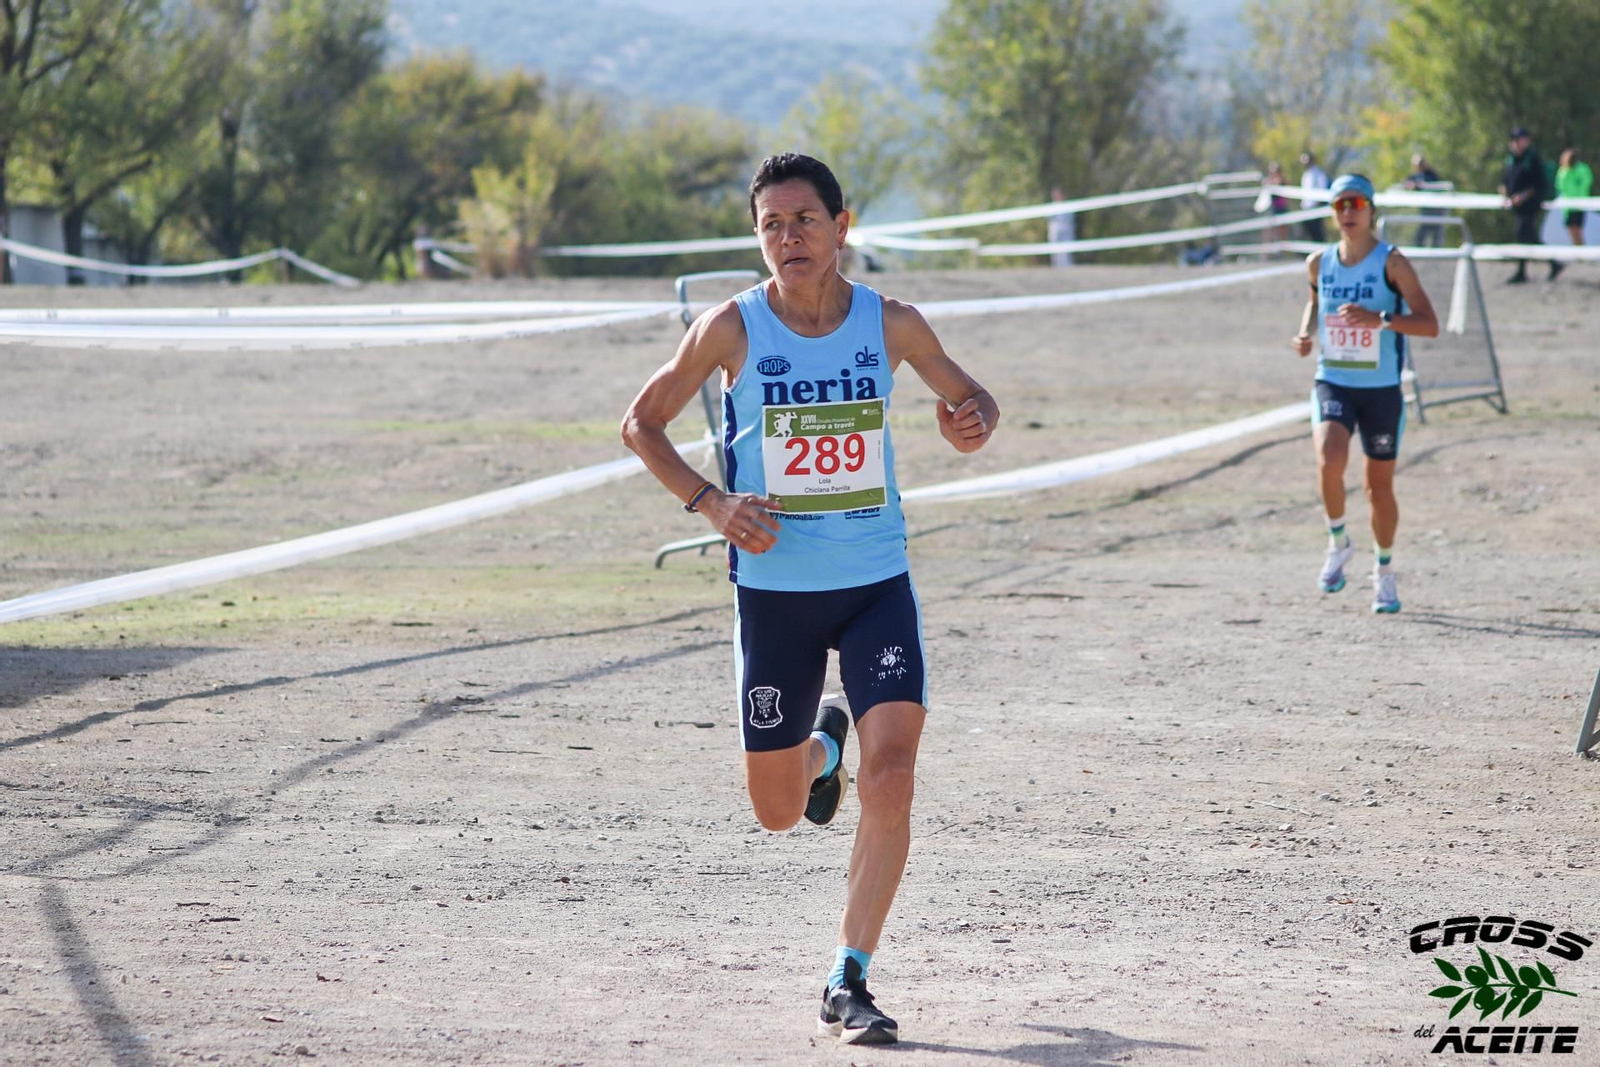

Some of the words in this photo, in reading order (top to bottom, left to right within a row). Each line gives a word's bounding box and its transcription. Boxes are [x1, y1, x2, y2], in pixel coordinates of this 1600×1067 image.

[1322, 282, 1374, 302] nerja
[1329, 329, 1373, 348] 1018
[758, 360, 790, 373] TROPS
[801, 423, 826, 431] Campo
[784, 433, 865, 476] 289
